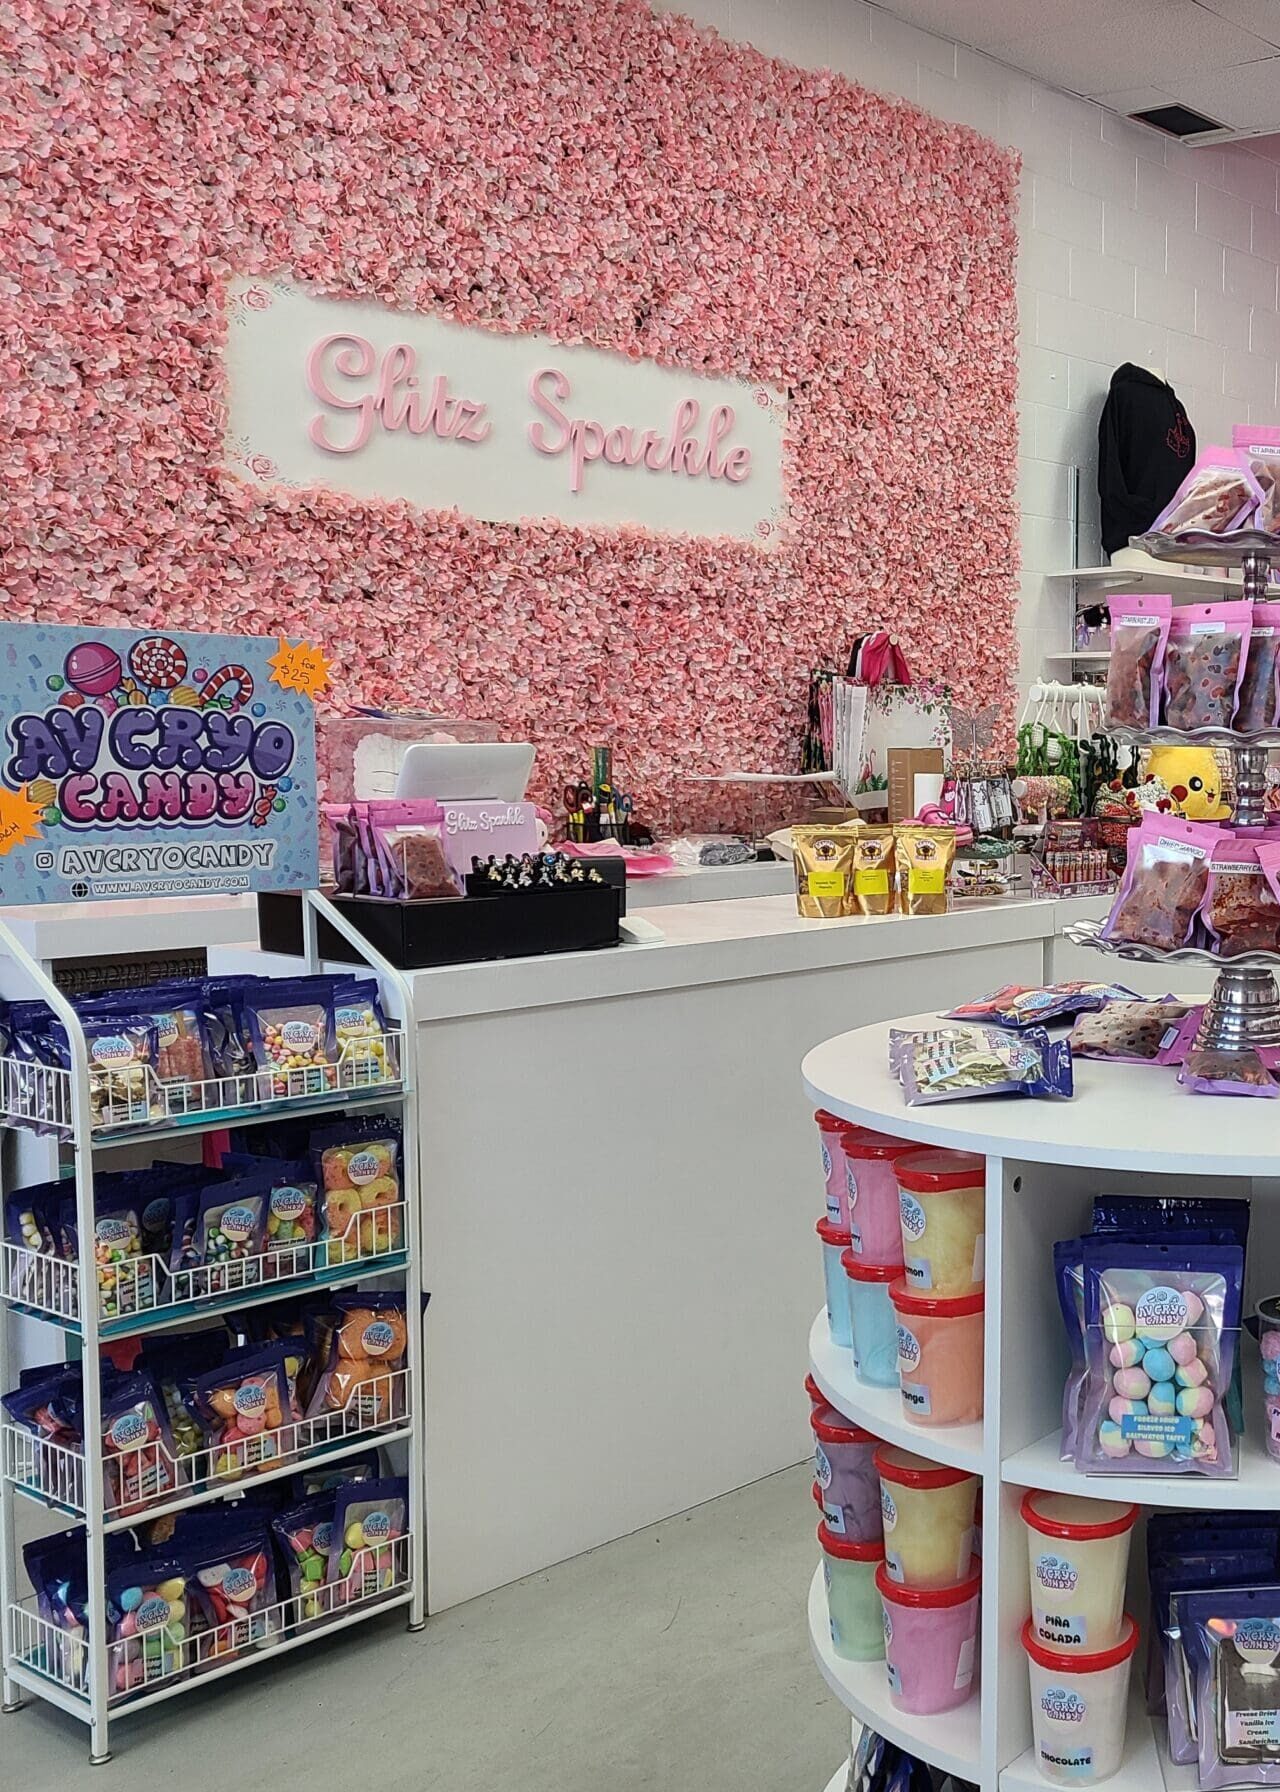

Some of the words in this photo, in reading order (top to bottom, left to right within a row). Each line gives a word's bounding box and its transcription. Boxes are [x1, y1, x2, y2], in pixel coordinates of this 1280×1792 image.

[305, 332, 491, 454] Glitz
[527, 367, 752, 493] Sparkle
[287, 652, 295, 665] 4
[280, 664, 310, 685] $25
[8, 707, 105, 783] AV
[109, 707, 295, 781] CRYO
[59, 772, 256, 822] CANDY
[446, 810, 478, 835] Glitz
[480, 806, 526, 833] Sparkle
[62, 843, 274, 875] AVCRYOCANDY
[1211, 862, 1251, 873] STRAWBERRY
[93, 876, 249, 895] WWW.AVCRYOCANDY.COM
[1137, 1304, 1153, 1318] AV
[1154, 1303, 1187, 1317] CRYO
[1145, 1315, 1179, 1325] CANDY
[1045, 1567, 1078, 1583] CRYO
[1041, 1578, 1071, 1589] CANDY
[1045, 1614, 1070, 1629] PIÑA
[1039, 1629, 1082, 1644] COLADA
[1242, 1640, 1276, 1650] CANDY
[1052, 1698, 1086, 1714] CRYO
[1047, 1709, 1078, 1721] CANDY
[1259, 1710, 1278, 1718] Dried
[1265, 1719, 1275, 1727] Ice
[1238, 1737, 1279, 1746] Sandwiches
[1040, 1750, 1092, 1766] CHOCOLATE
